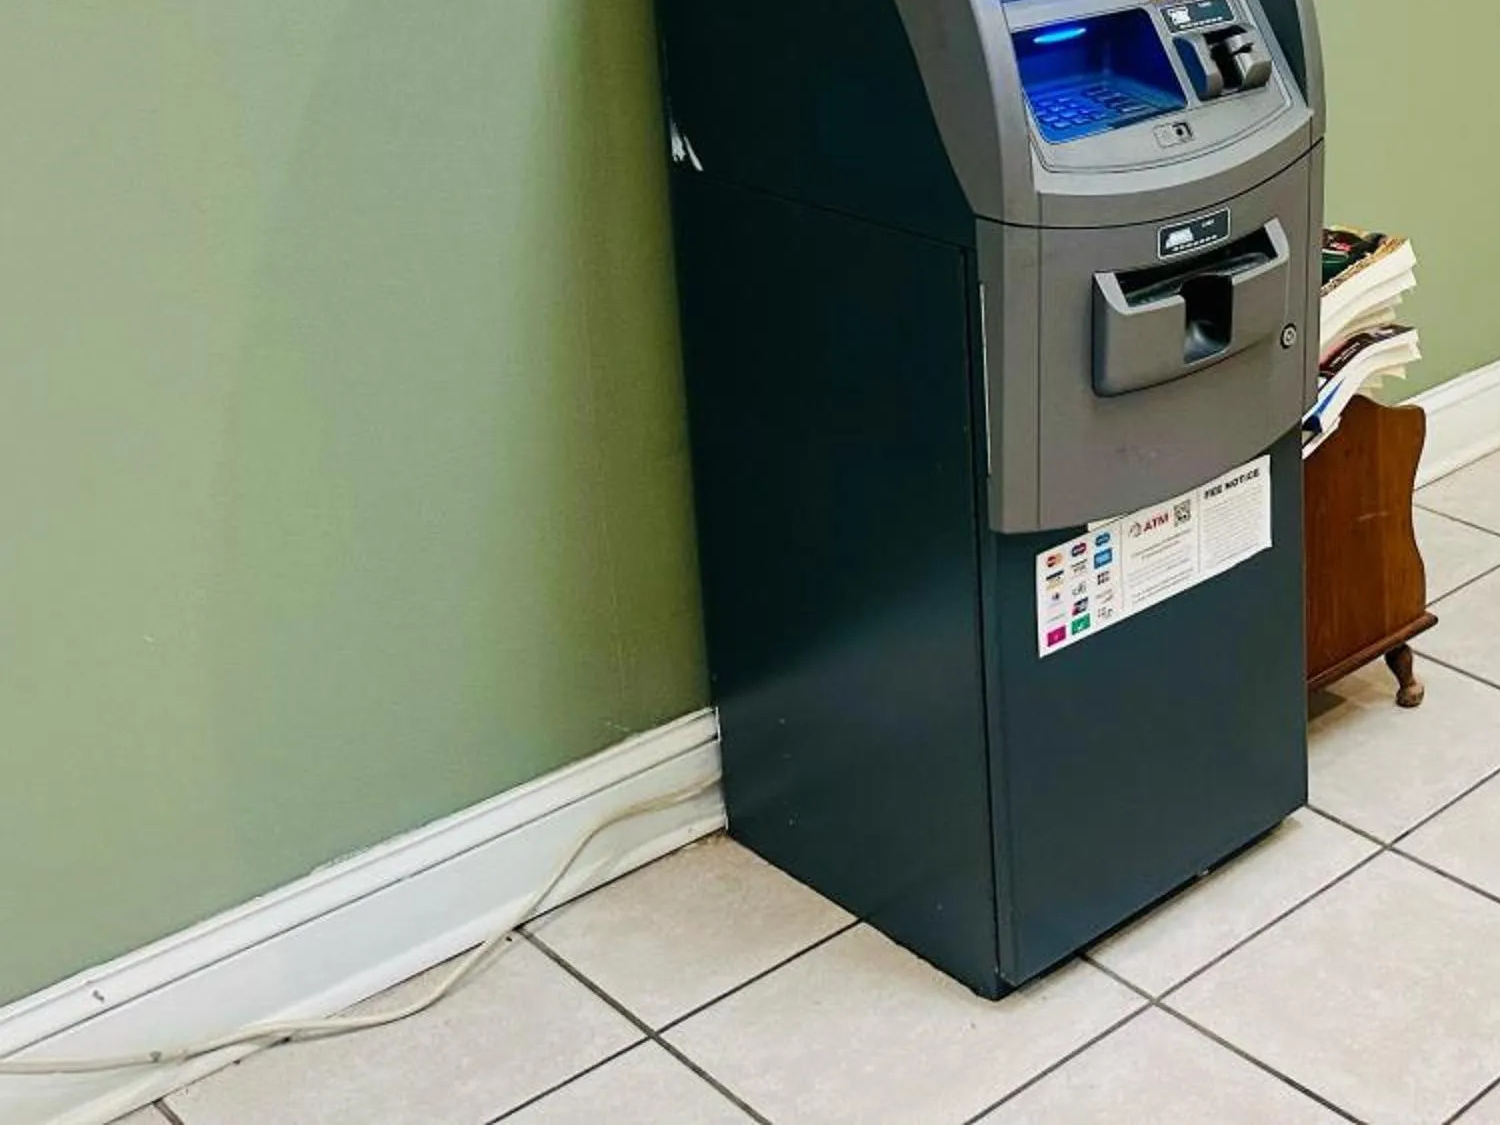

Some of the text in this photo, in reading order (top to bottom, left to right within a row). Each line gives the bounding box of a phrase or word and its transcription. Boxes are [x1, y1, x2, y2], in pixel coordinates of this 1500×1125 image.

[1204, 468, 1260, 500] FEE NOTICE
[1143, 512, 1169, 532] ATM
